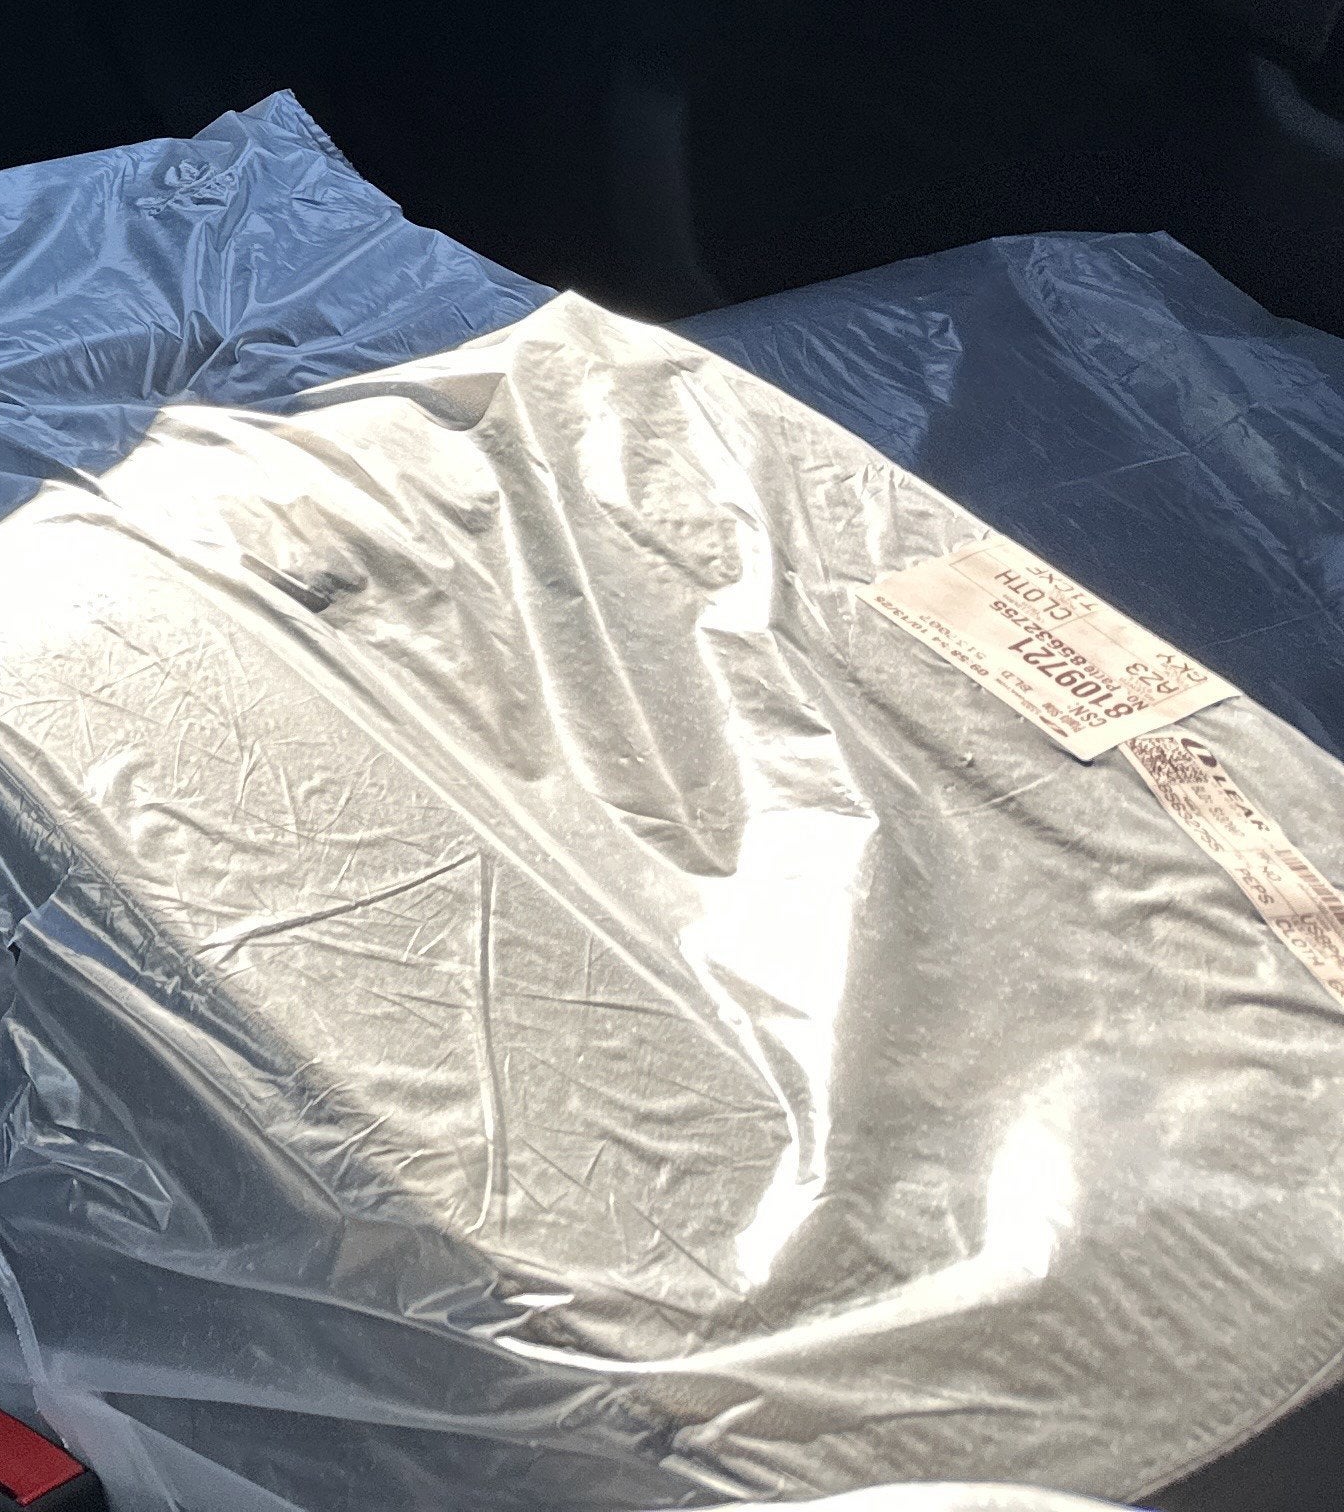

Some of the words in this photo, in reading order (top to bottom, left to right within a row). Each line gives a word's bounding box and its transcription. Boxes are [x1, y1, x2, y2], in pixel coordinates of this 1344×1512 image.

[994, 569, 1072, 619] CLOTH
[990, 601, 1086, 665] 85632755
[1008, 637, 1133, 718] 8109721
[1084, 666, 1121, 692] Parte
[1126, 663, 1179, 694] AZ3
